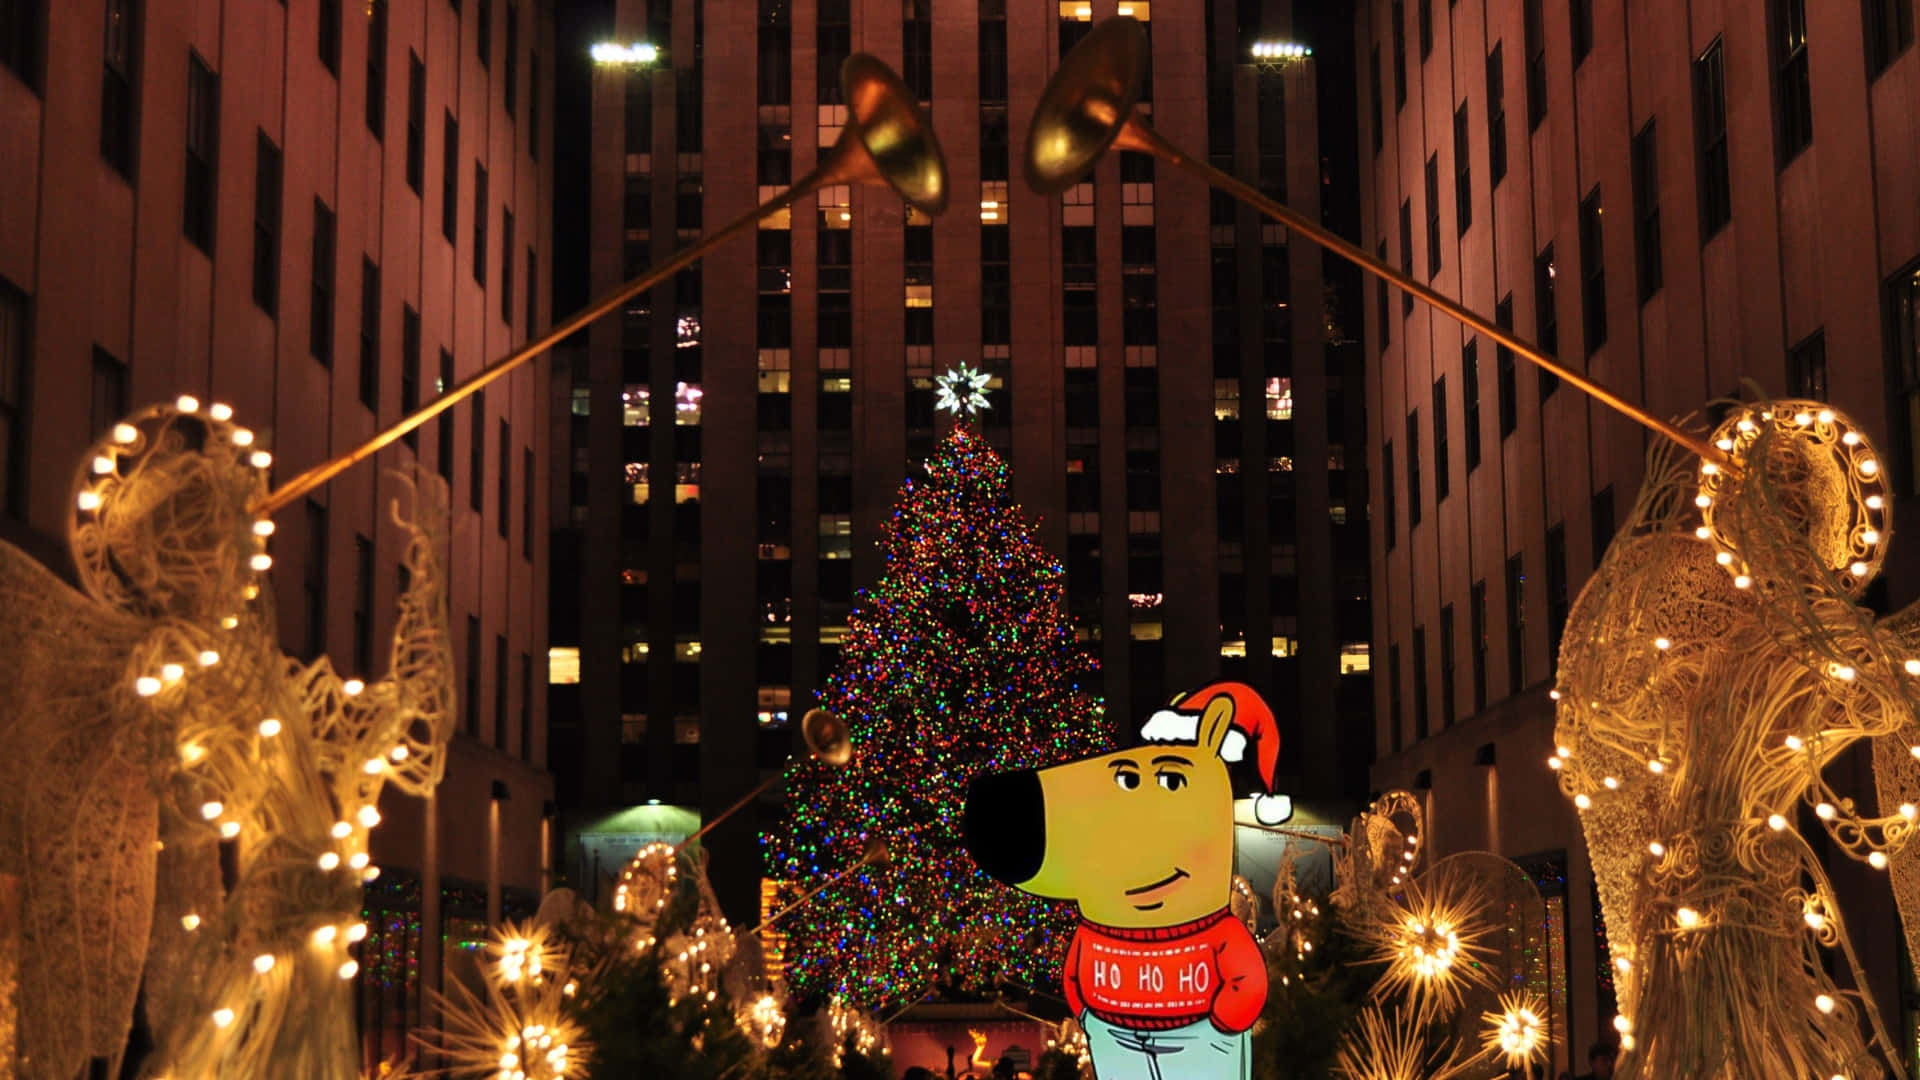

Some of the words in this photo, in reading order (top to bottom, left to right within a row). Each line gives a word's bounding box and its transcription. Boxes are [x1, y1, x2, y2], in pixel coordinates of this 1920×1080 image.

[1094, 959, 1121, 990] HO
[1138, 963, 1164, 993] HO
[1179, 961, 1210, 993] HO
